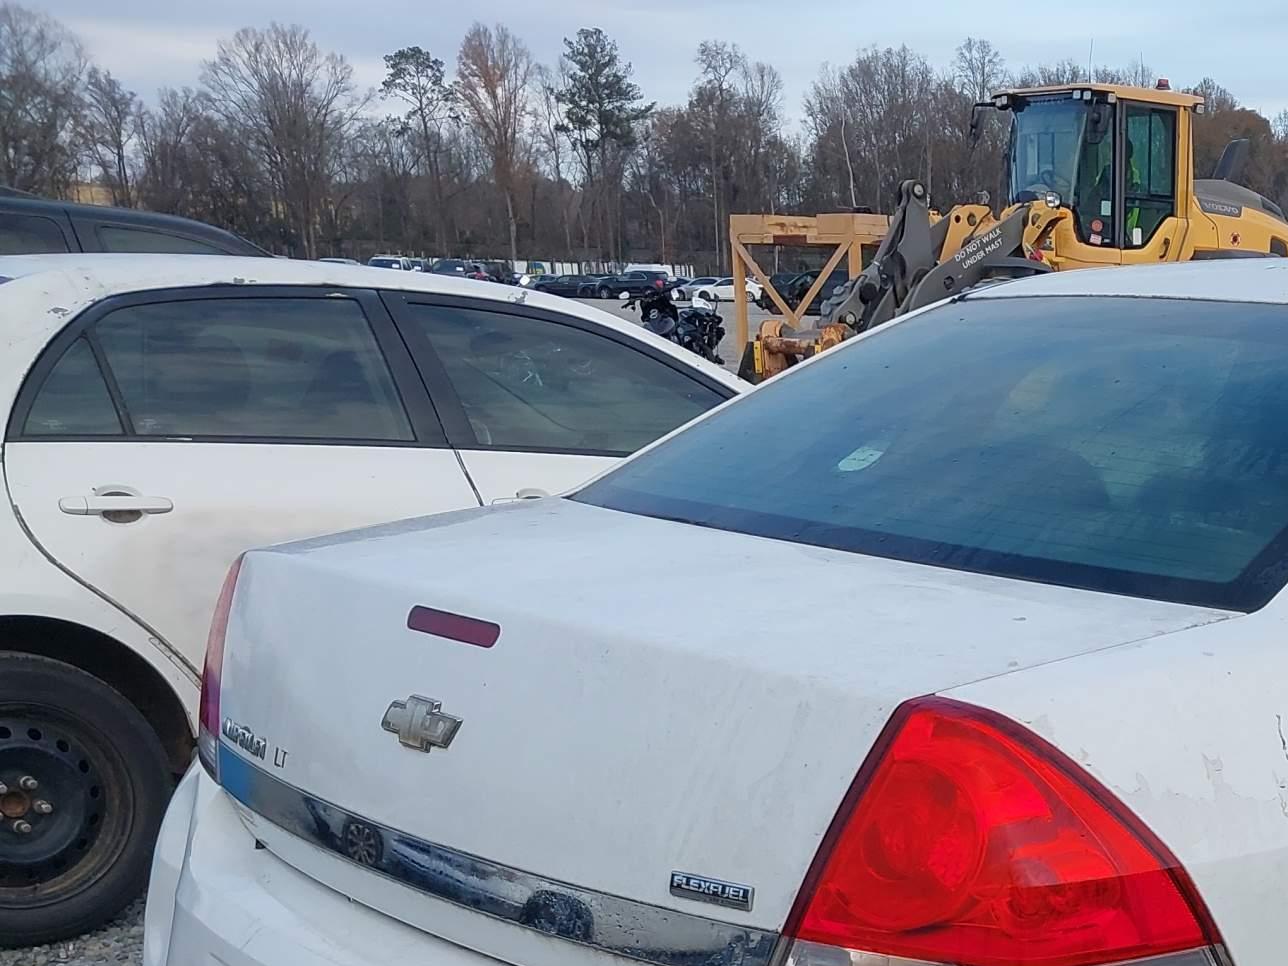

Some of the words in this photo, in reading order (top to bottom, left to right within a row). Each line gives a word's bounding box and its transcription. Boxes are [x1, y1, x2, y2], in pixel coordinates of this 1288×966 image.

[1204, 203, 1239, 214] VOLVO
[954, 251, 966, 262] DO
[966, 240, 981, 255] NOT
[981, 227, 1002, 244] WALK
[962, 250, 986, 269] UNDER
[985, 238, 1003, 254] MAST
[274, 746, 288, 768] LT
[672, 875, 749, 902] FLEXFUEL
